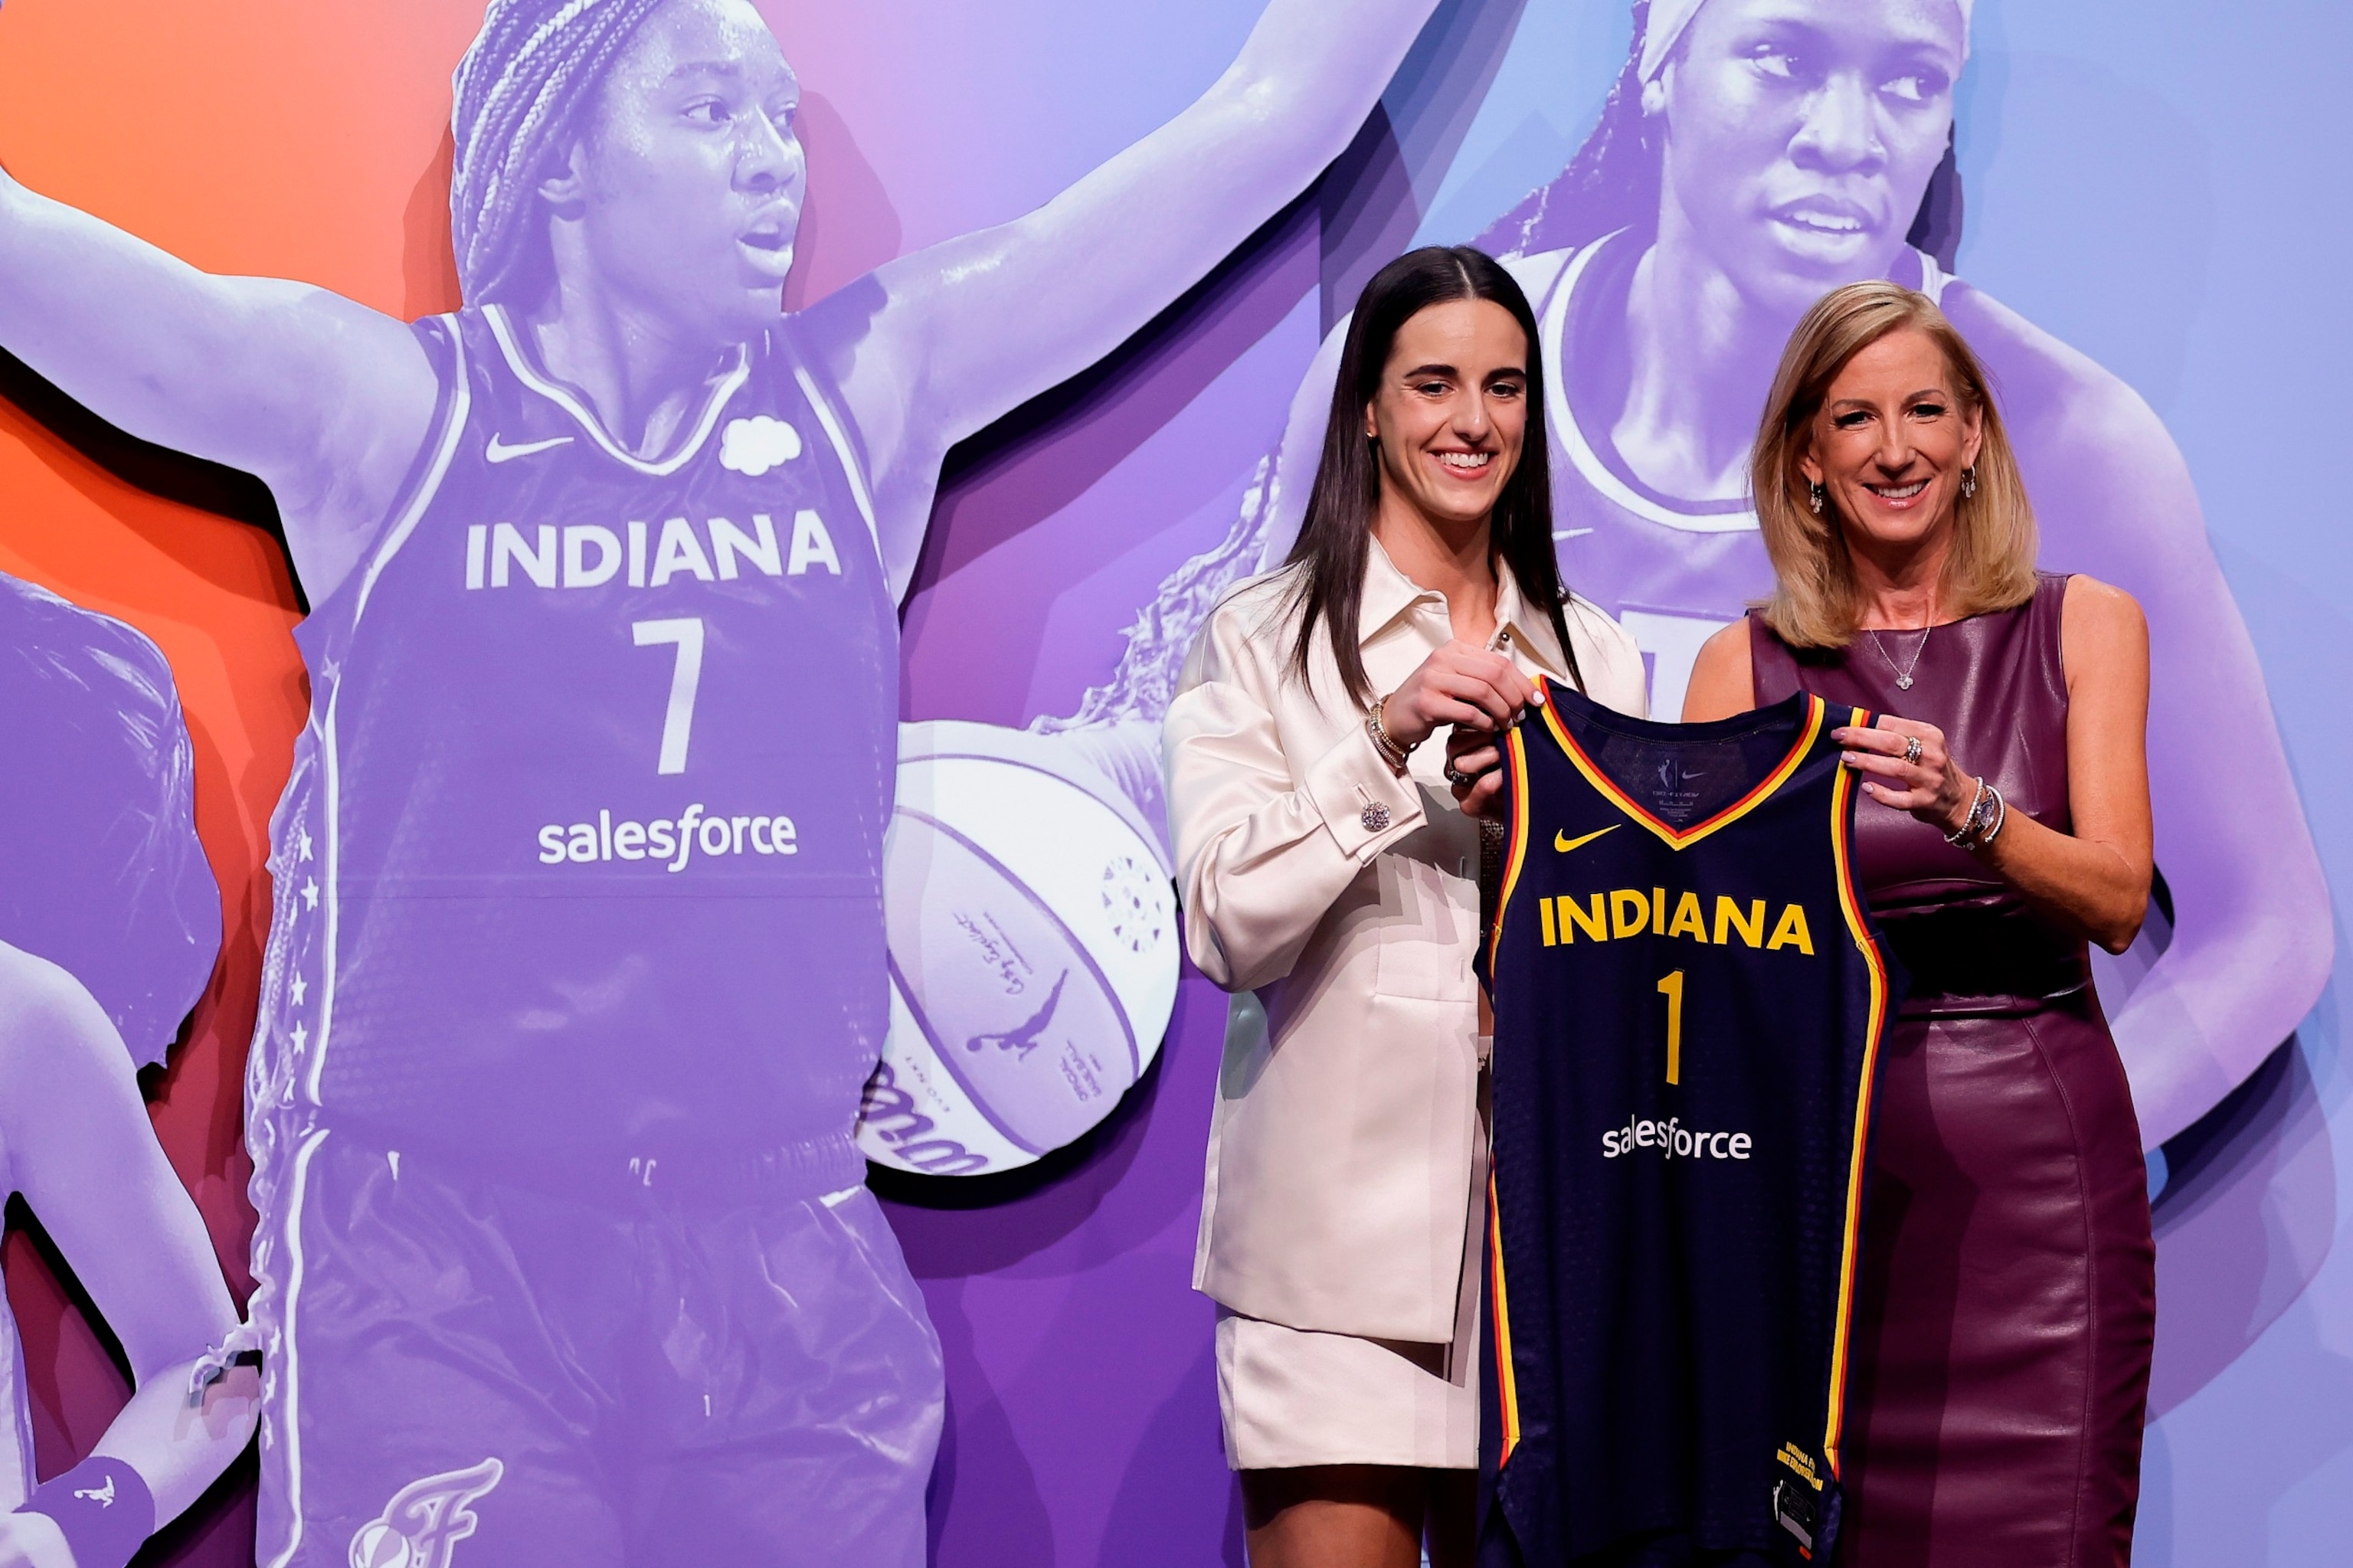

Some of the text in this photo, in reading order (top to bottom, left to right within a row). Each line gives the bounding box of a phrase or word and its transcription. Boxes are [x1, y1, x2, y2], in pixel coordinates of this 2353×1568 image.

[466, 509, 841, 590] INDIANA
[632, 617, 705, 775] 7
[538, 804, 797, 872] salesforce
[1540, 886, 1815, 955] INDIANA
[1657, 969, 1685, 1085] 1
[1602, 1115, 1752, 1159] salesforce
